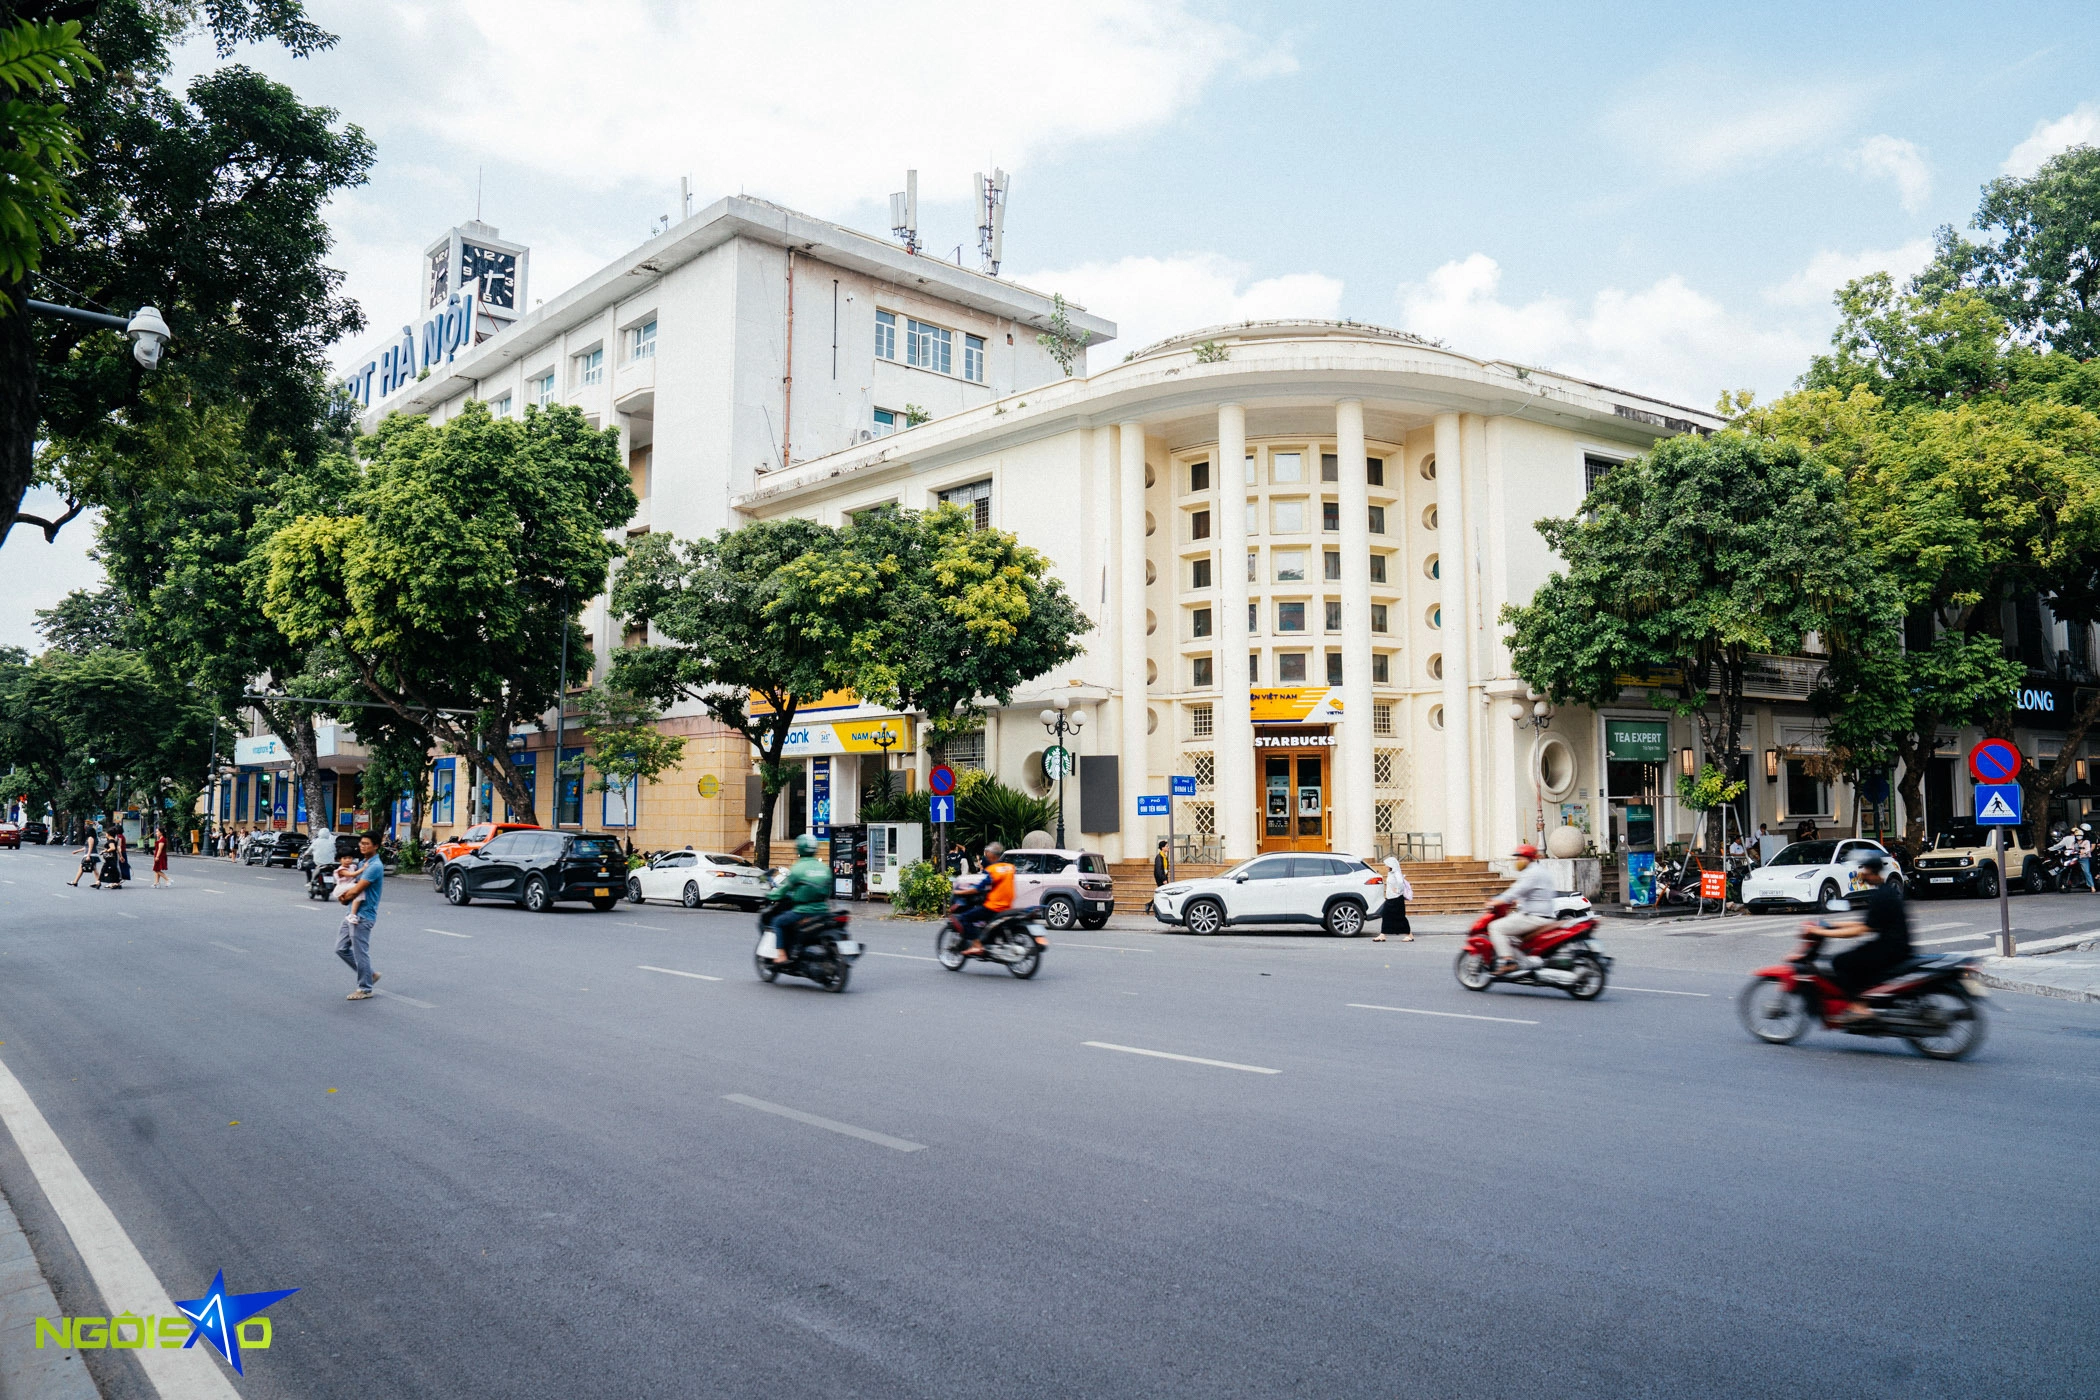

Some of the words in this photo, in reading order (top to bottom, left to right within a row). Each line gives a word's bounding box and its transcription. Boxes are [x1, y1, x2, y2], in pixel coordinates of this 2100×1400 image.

[484, 250, 495, 261] 12
[463, 266, 472, 276] 9
[504, 277, 514, 287] 3
[482, 292, 492, 302] 6
[379, 325, 416, 397] HÀ
[421, 293, 472, 371] NỘI
[1261, 692, 1278, 704] VIỆT
[852, 732, 868, 741] NAM
[1255, 735, 1336, 747] STARBUCKS
[1614, 732, 1631, 743] TEA
[1631, 732, 1662, 743] EXPERT
